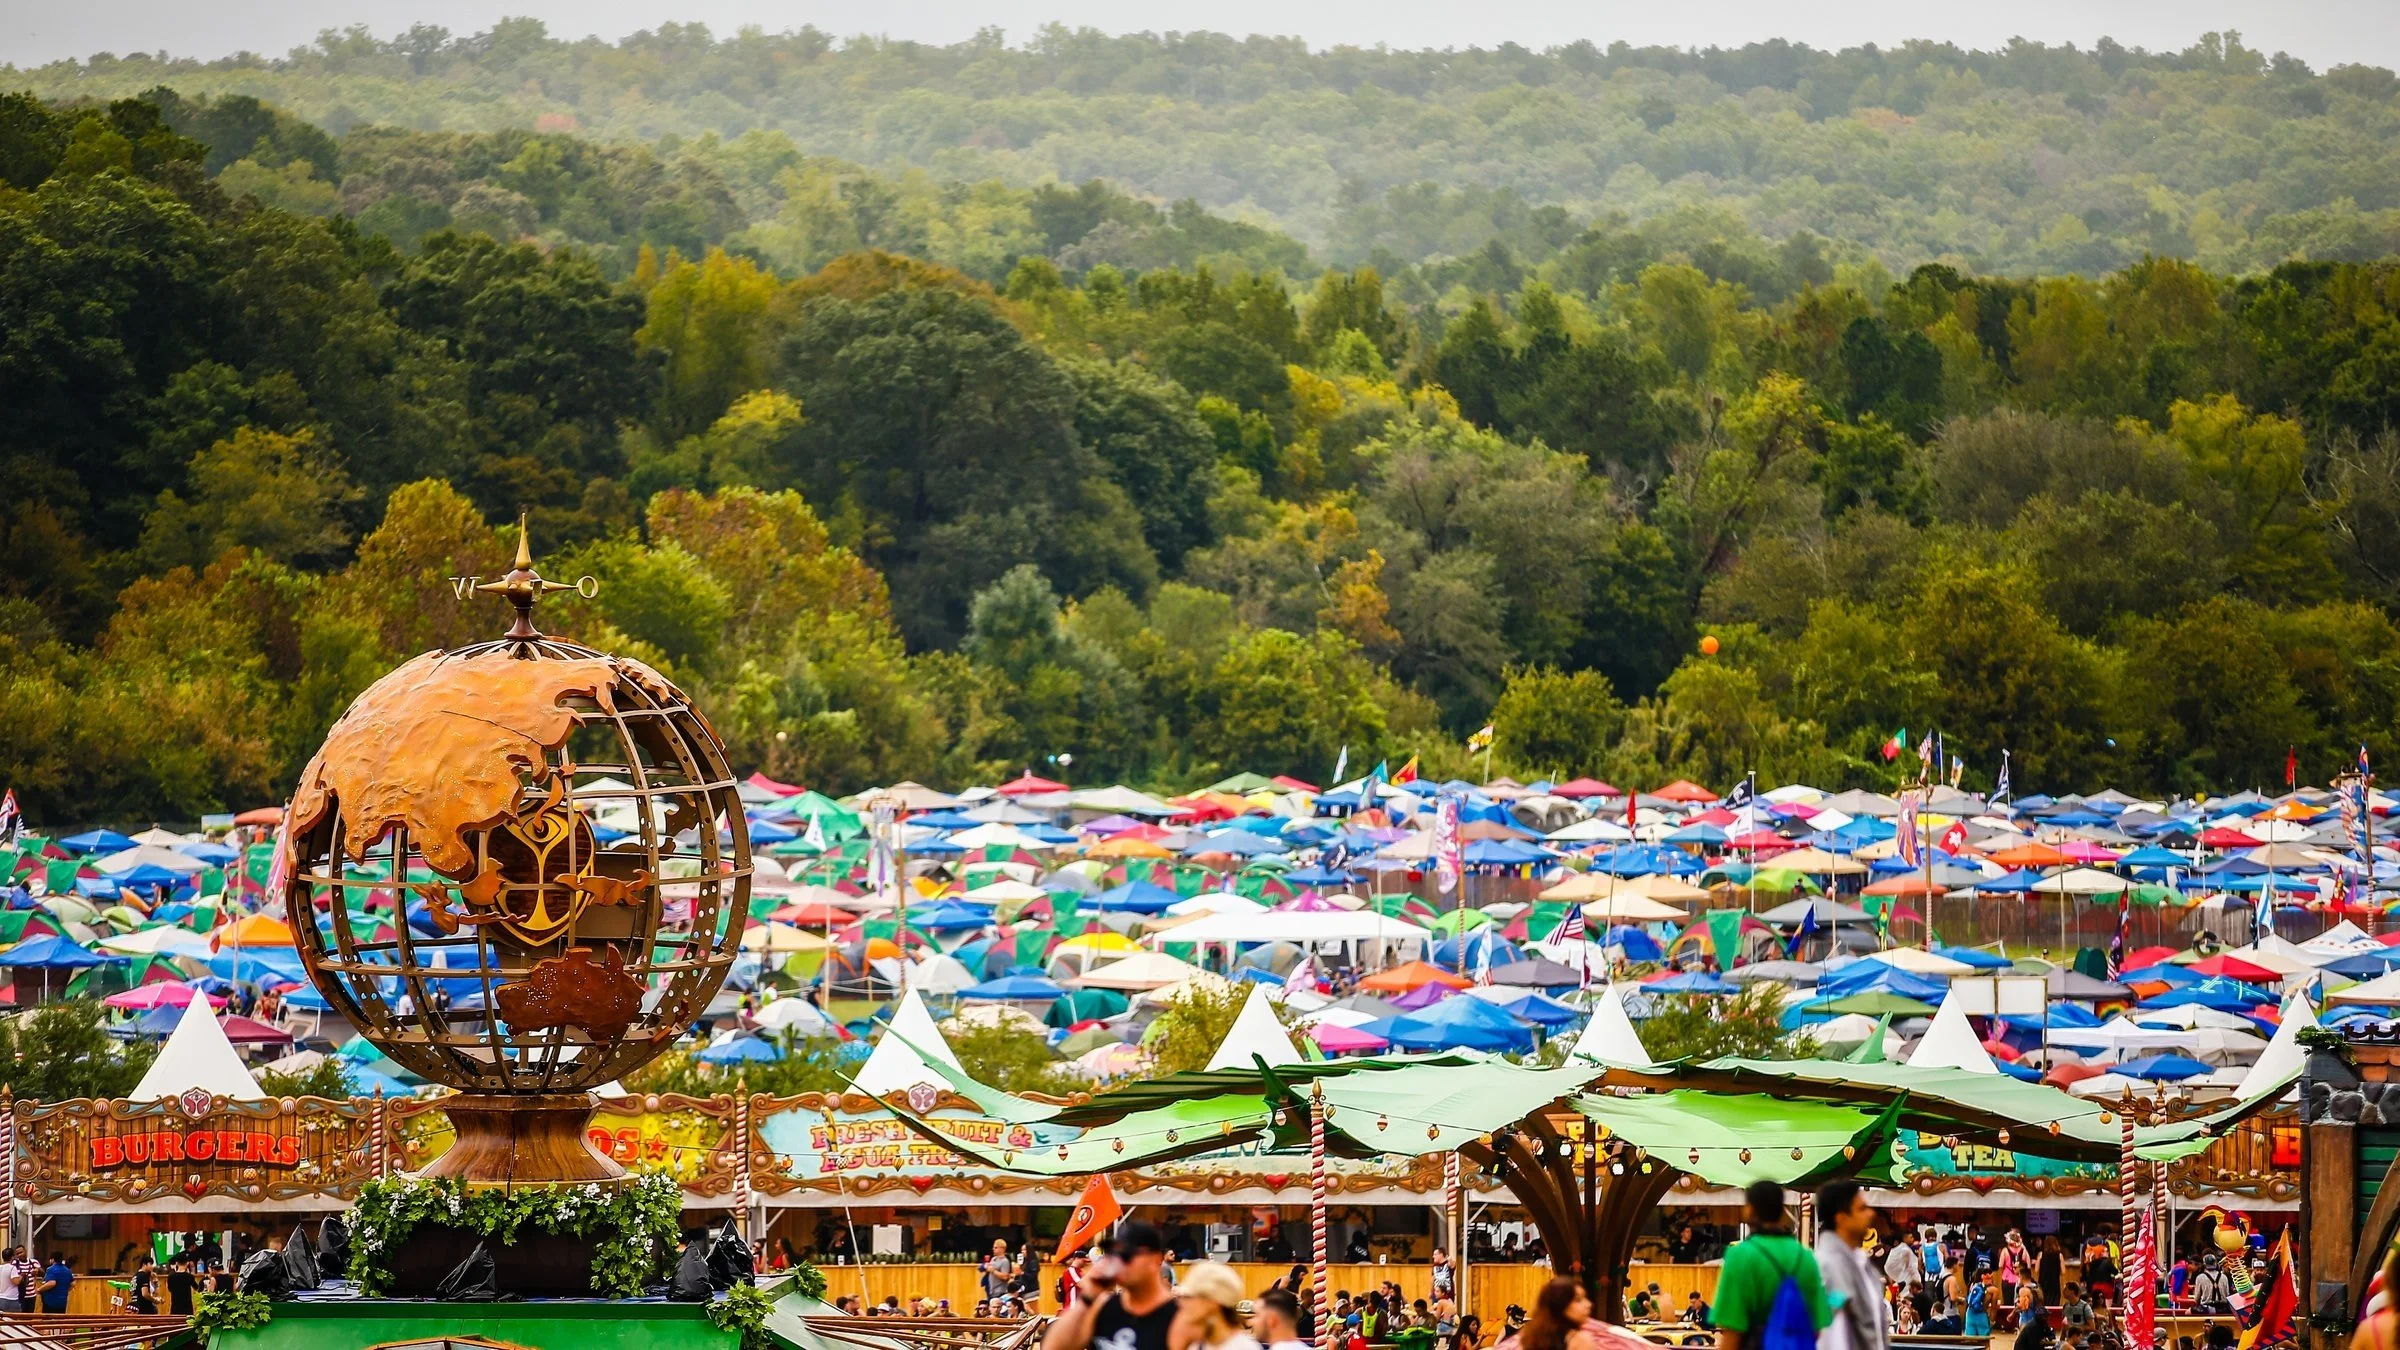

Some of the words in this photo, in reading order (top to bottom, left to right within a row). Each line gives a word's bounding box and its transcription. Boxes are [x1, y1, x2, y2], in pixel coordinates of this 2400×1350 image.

[448, 576, 481, 600] W
[913, 1118, 1005, 1144] RUIT
[1007, 1125, 1033, 1148] &
[90, 1130, 301, 1168] BURGERS
[1952, 1143, 2016, 1171] TEA
